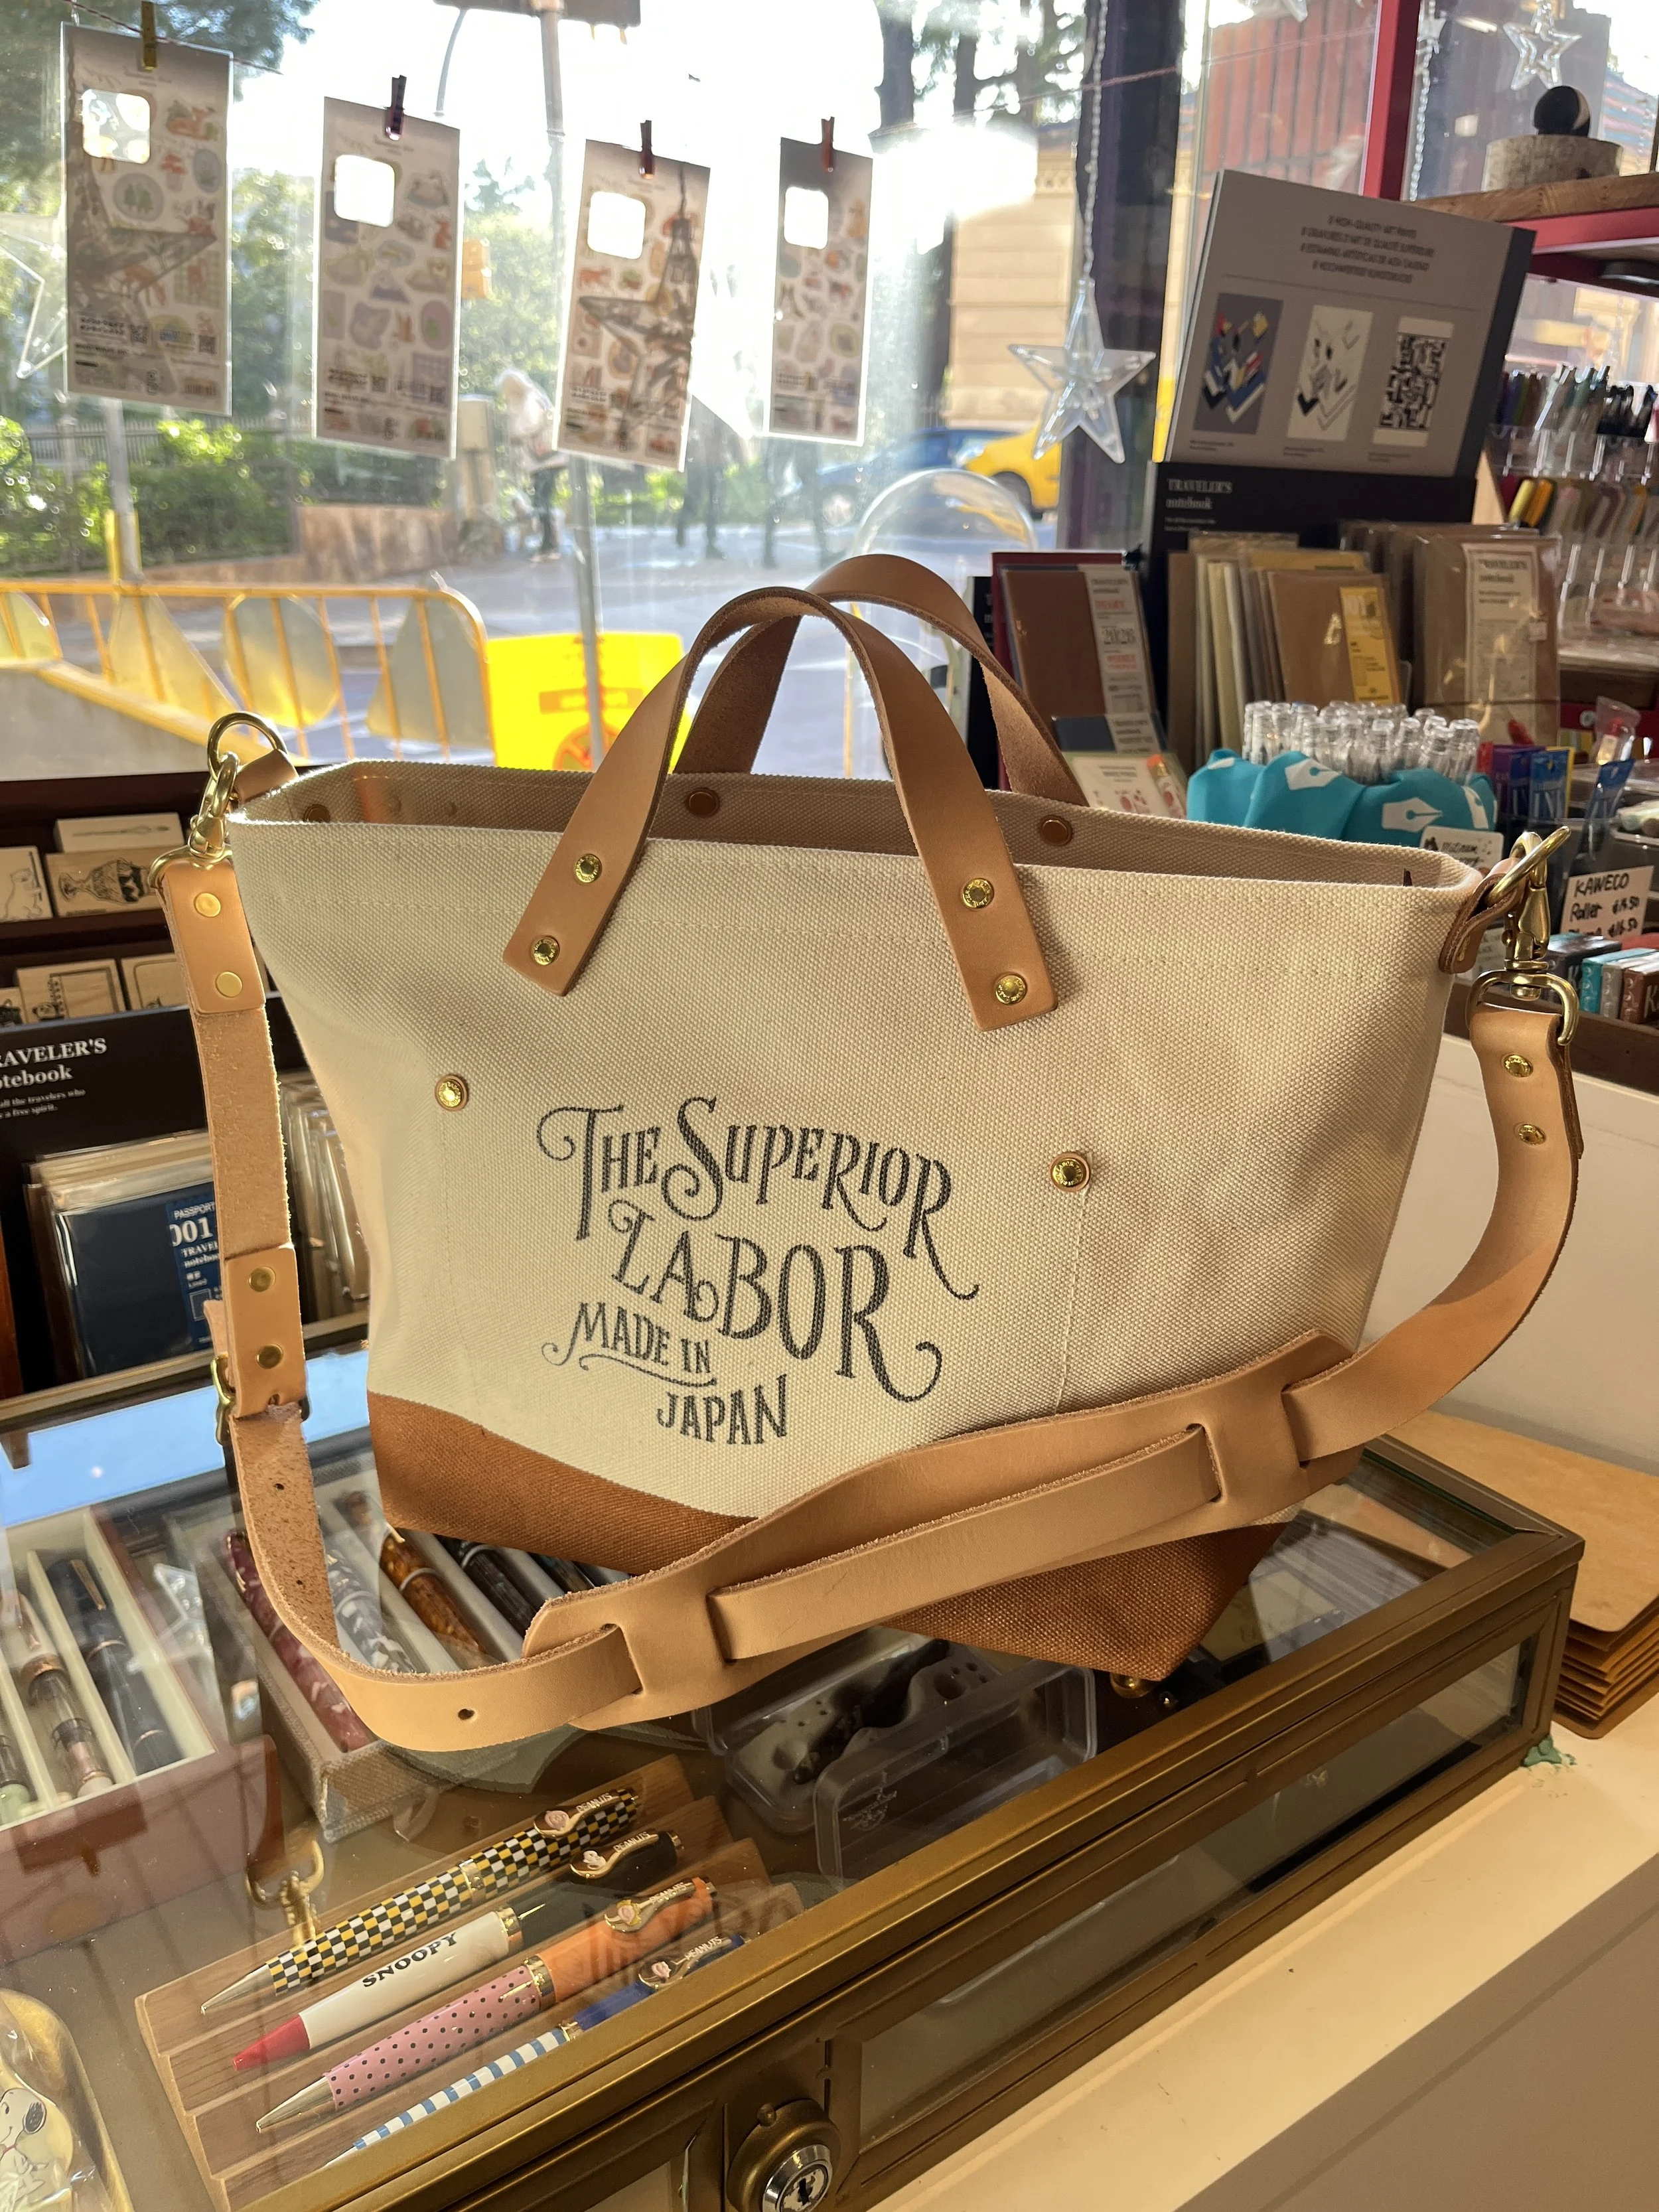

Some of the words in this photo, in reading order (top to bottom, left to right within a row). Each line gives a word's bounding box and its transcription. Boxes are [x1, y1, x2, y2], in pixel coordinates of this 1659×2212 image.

[1574, 873, 1630, 899] KAWECO
[12, 1097, 27, 1106] the
[28, 1092, 66, 1104] travelers
[68, 1088, 86, 1097] who
[13, 1108, 31, 1117] free
[174, 1201, 215, 1220] PASSPORT
[536, 1104, 661, 1241] THE
[661, 1096, 980, 1301] SUPERIOR
[608, 1199, 943, 1404] LABOR
[541, 1301, 670, 1367] MADE
[681, 1337, 711, 1374] IN
[657, 1374, 789, 1445] JAPAN
[575, 1793, 612, 1813] PEANUTS
[613, 1831, 650, 1853] PEANUTS
[362, 1932, 458, 1988] SNOOPY
[684, 1936, 722, 1960] PEANUTS
